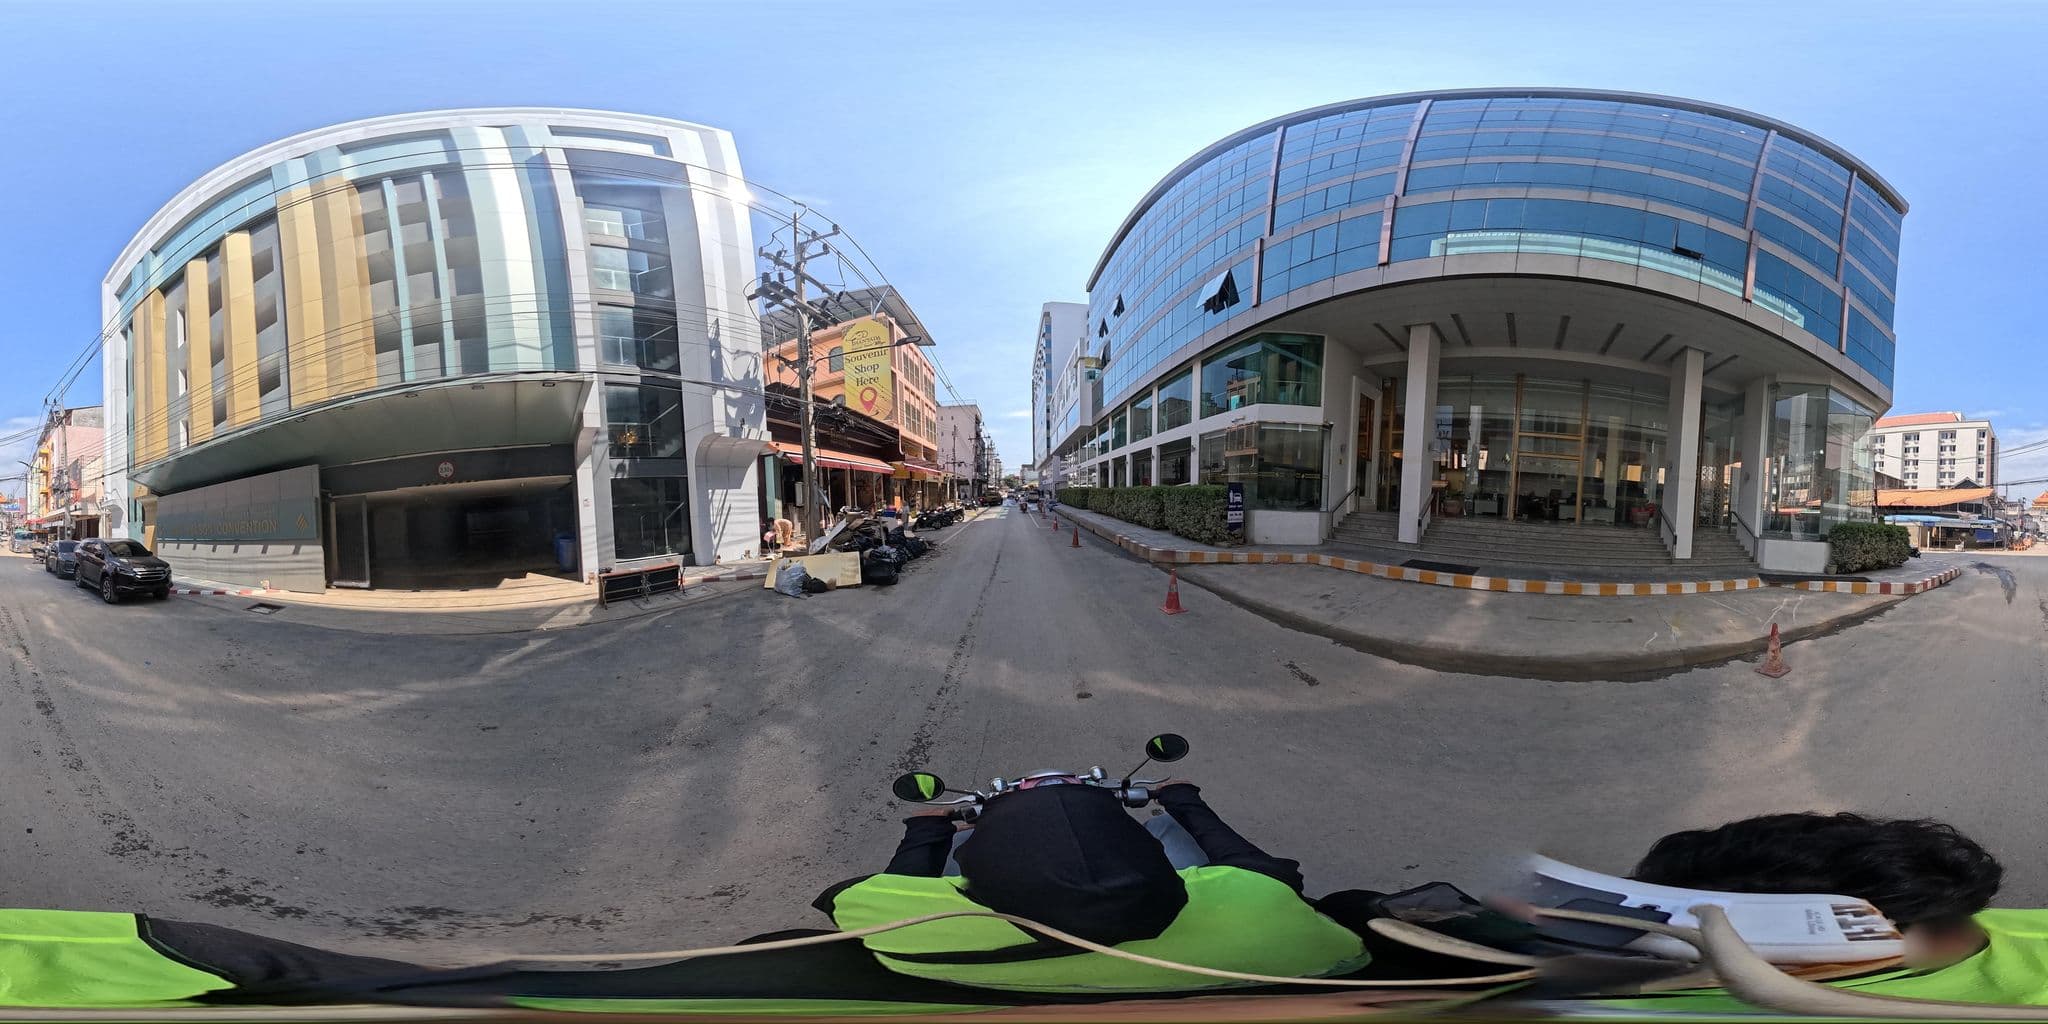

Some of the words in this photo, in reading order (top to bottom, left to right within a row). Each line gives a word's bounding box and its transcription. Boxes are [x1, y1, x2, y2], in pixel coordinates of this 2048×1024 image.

[845, 349, 888, 363] Souvenir
[854, 363, 880, 374] Shop
[856, 377, 879, 386] Here
[215, 519, 278, 537] CONVENTION
